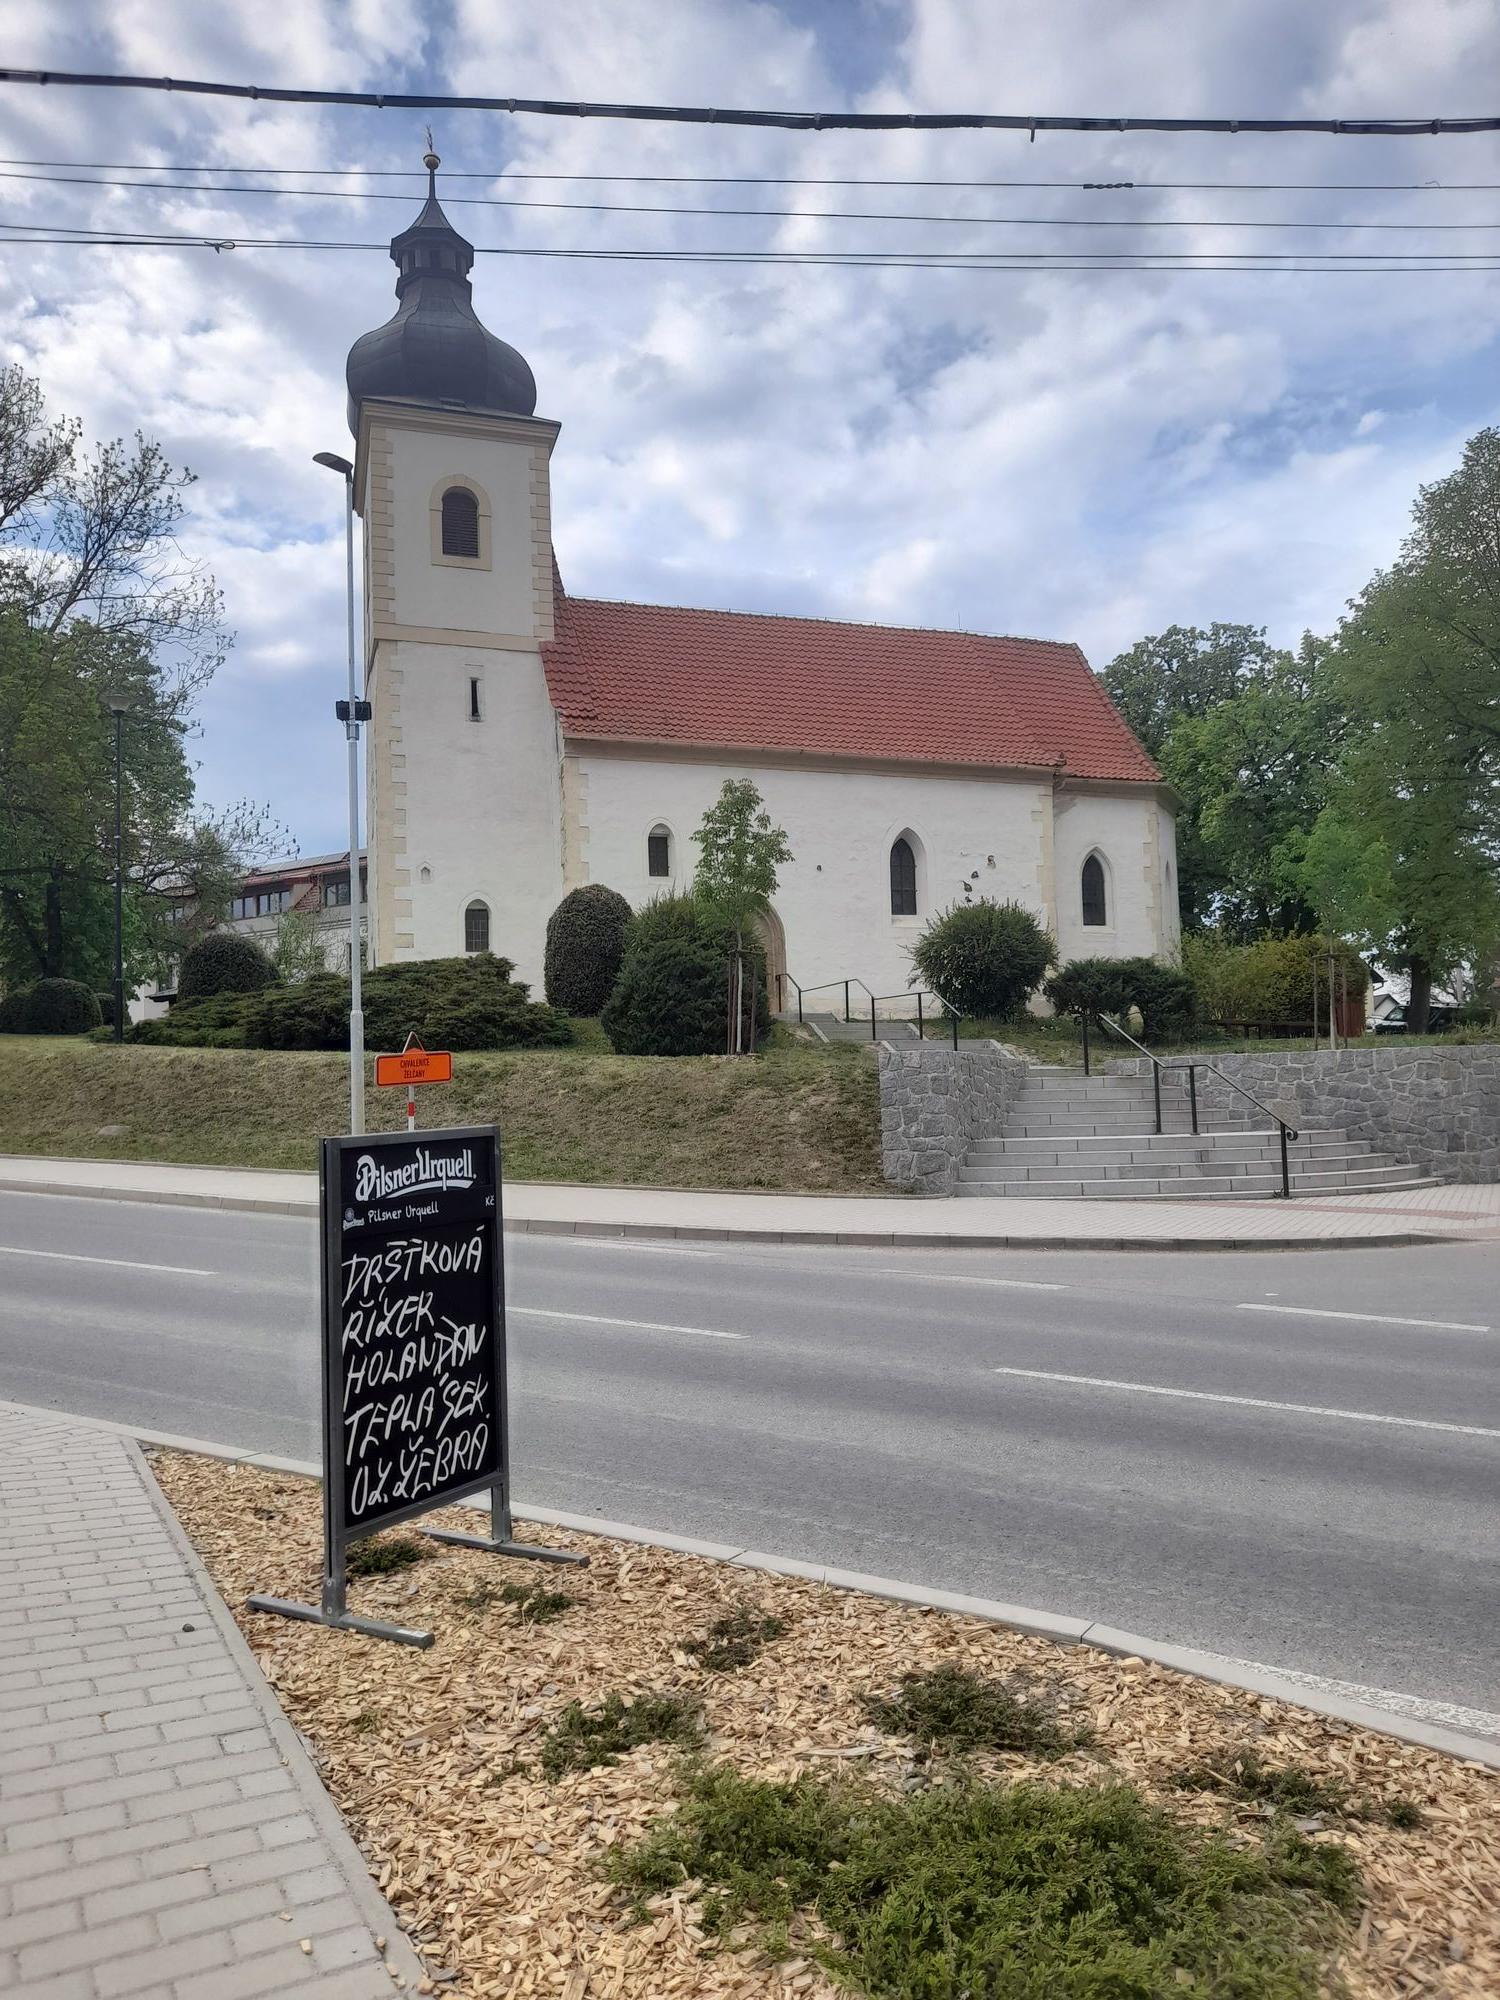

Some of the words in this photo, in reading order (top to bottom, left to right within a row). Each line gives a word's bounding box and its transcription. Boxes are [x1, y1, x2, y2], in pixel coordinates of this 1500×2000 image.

[355, 1154, 419, 1202] Pilsner
[367, 1209, 402, 1223] Pilsner
[405, 1200, 439, 1223] Urquell
